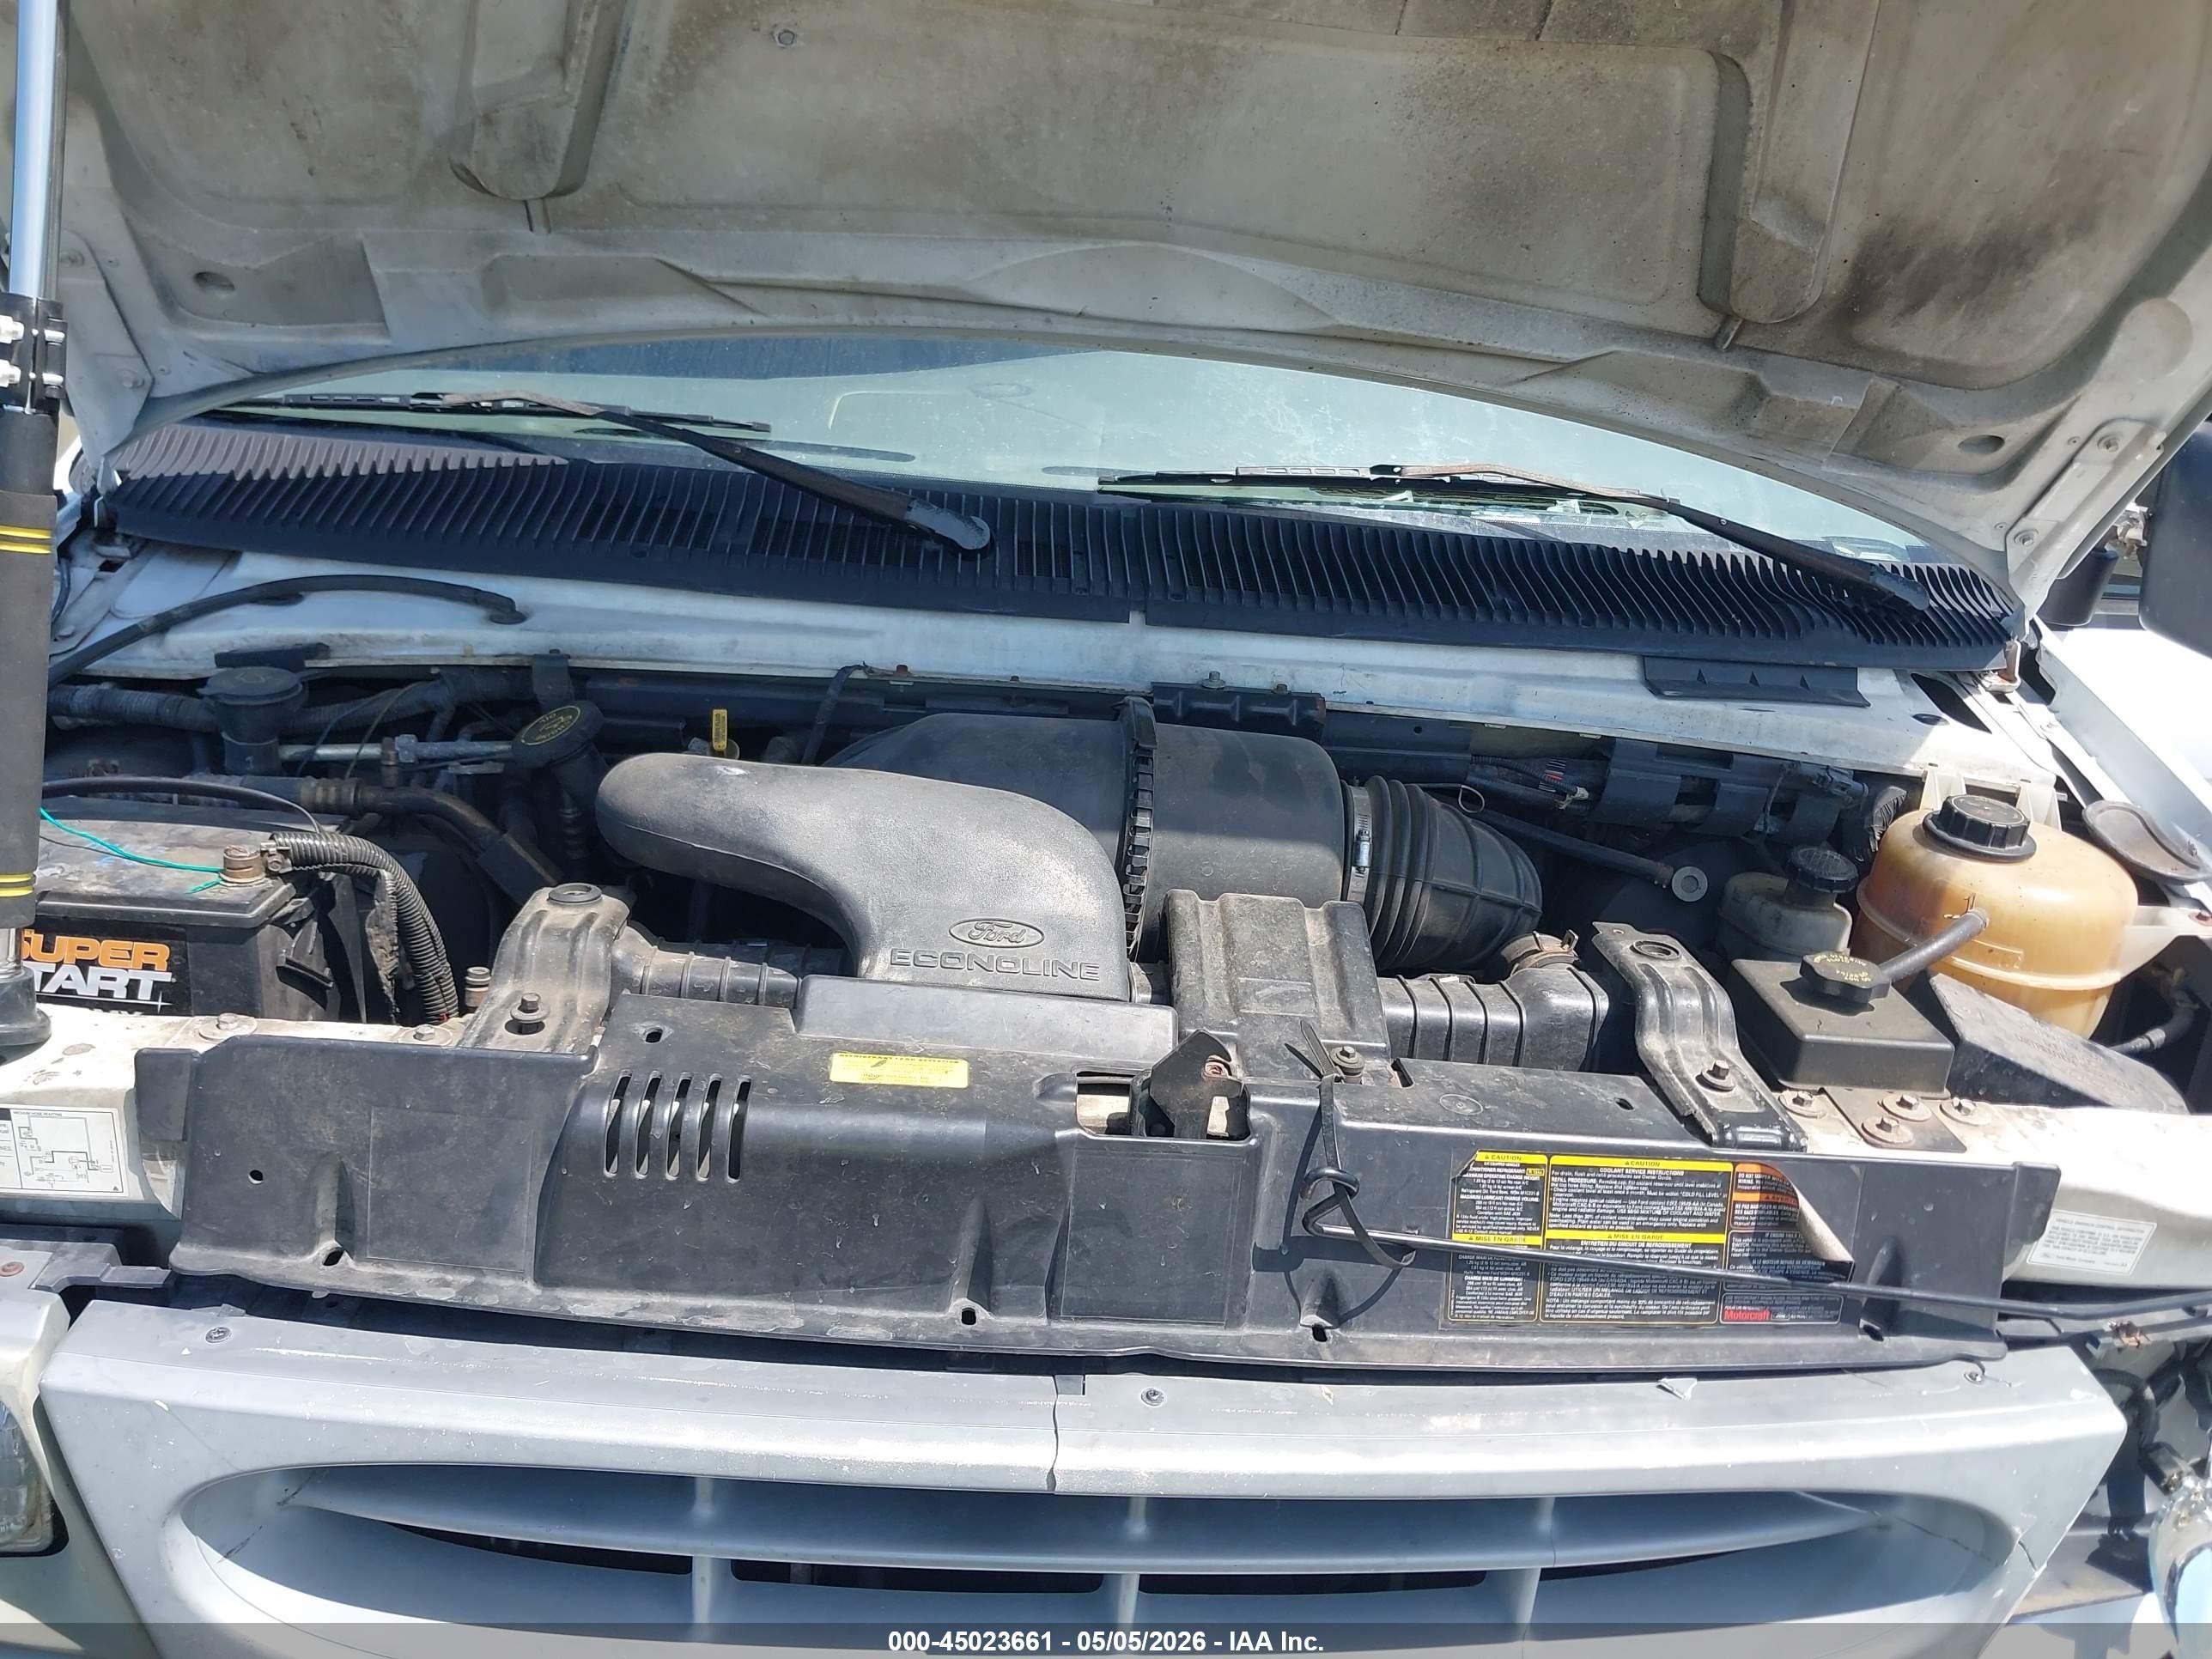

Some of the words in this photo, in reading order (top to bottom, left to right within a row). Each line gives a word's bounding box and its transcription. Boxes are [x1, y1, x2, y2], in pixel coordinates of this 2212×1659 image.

[968, 921, 1027, 944] Ford
[890, 947, 1100, 981] ECONOLINE
[23, 961, 173, 1000] TART
[1724, 1310, 1770, 1321] Motorcraft
